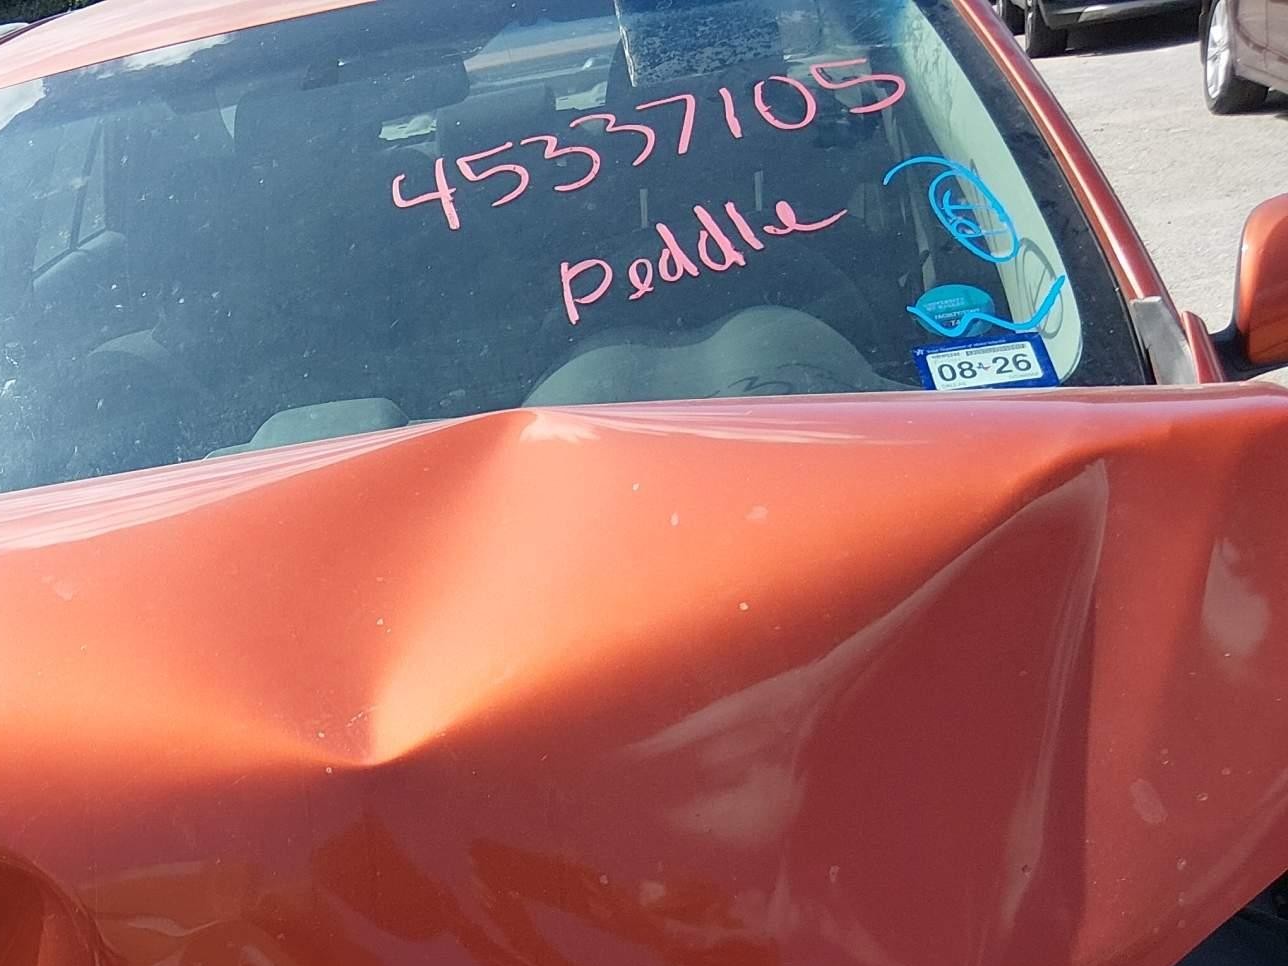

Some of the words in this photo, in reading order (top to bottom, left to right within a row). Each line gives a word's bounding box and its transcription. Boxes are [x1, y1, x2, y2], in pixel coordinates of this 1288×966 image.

[392, 58, 907, 230] 45337105
[937, 361, 978, 382] 08
[991, 353, 1032, 375] 26
